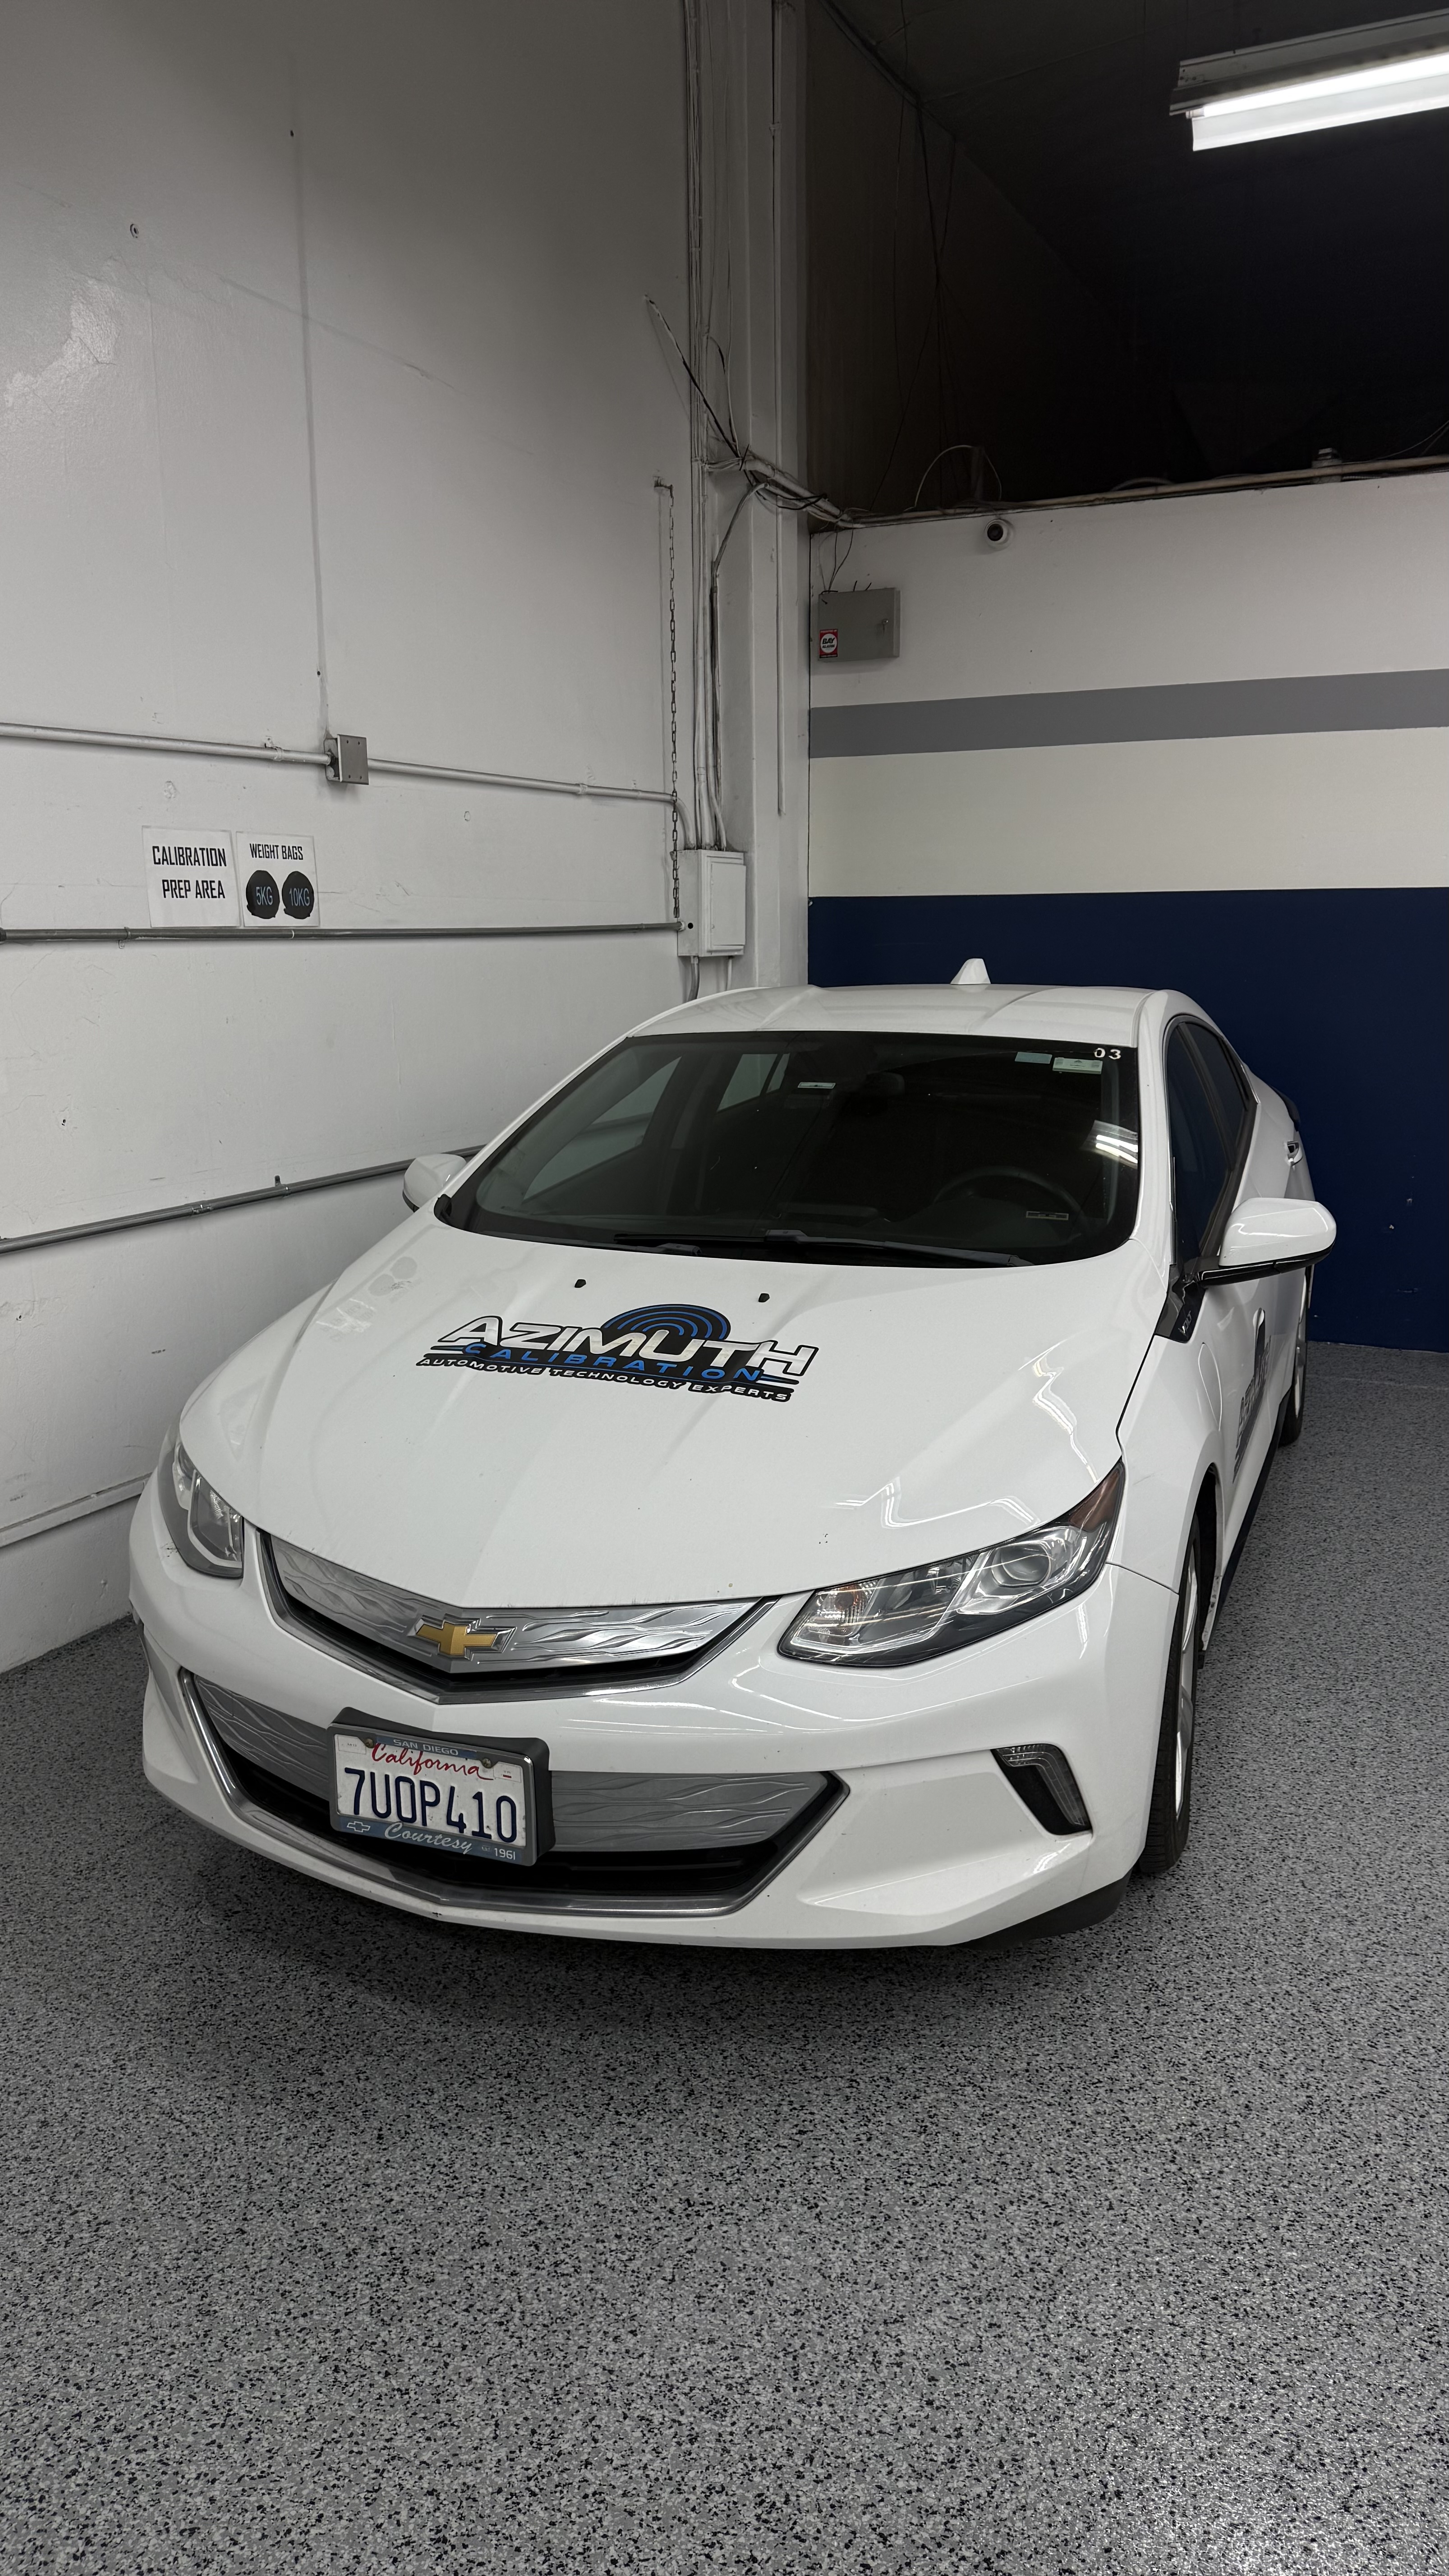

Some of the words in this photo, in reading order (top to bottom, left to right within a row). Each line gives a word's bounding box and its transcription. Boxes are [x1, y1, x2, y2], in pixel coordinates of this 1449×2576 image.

[152, 846, 227, 867] CALIBRATION
[249, 843, 280, 860] WEIGHT
[281, 845, 304, 860] BAGS
[161, 879, 191, 899] PREP
[195, 880, 226, 899] AREA
[256, 886, 273, 906] 5KG
[289, 888, 310, 906] 10KG
[438, 1315, 818, 1376] AZIMUTH
[465, 1343, 760, 1381] CALIBRATION
[419, 1358, 542, 1374] AUTOMOTIVE
[552, 1369, 682, 1388] TECHNOLOGY
[692, 1385, 787, 1400] EXPERTS
[393, 1739, 419, 1749] SAN
[423, 1743, 459, 1756] DIEGO
[372, 1742, 494, 1780] California
[344, 1767, 517, 1844] 7UOP410
[384, 1822, 473, 1854] Courtesy
[494, 1847, 515, 1860] 1961
